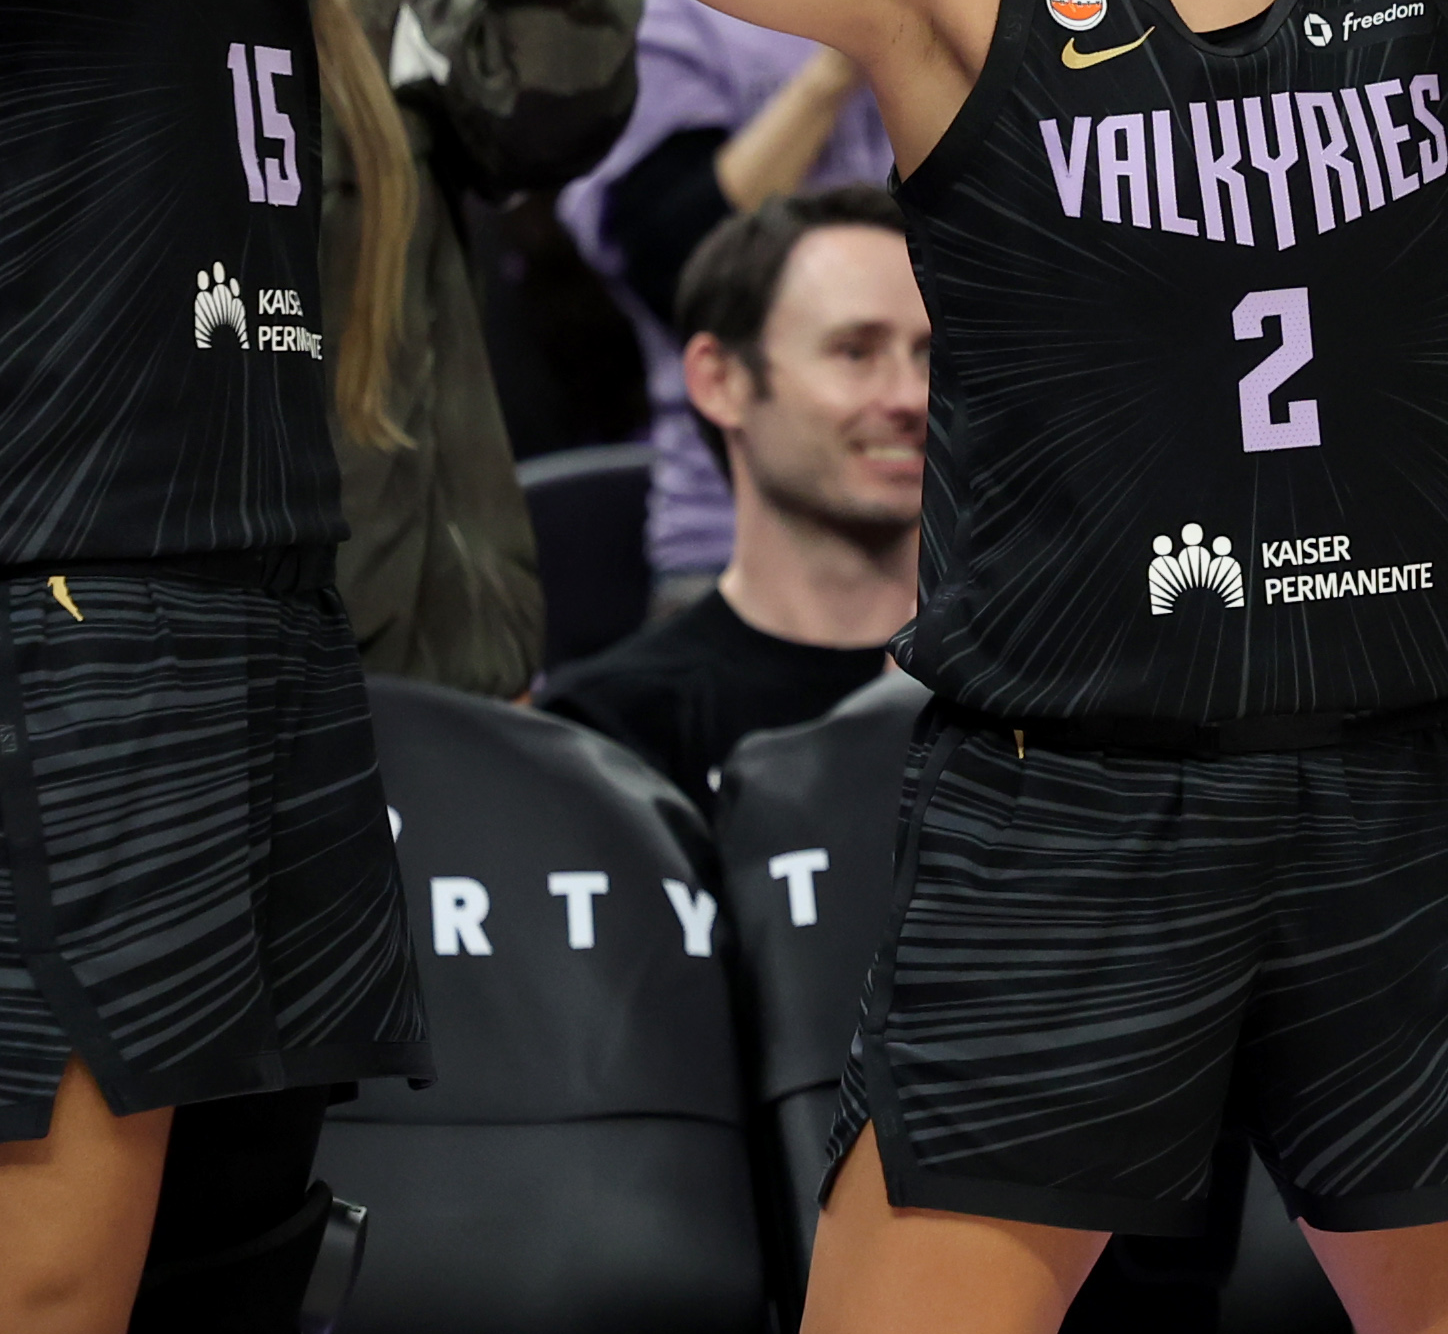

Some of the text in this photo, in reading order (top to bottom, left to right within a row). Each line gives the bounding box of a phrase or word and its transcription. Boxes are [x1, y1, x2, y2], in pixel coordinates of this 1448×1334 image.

[1343, 2, 1425, 41] freedom
[227, 43, 302, 207] 15
[1039, 74, 1448, 251] VALKYRIES
[1232, 287, 1321, 452] 2
[1262, 535, 1351, 568] KAISER
[1265, 562, 1434, 604] PERMANENTE
